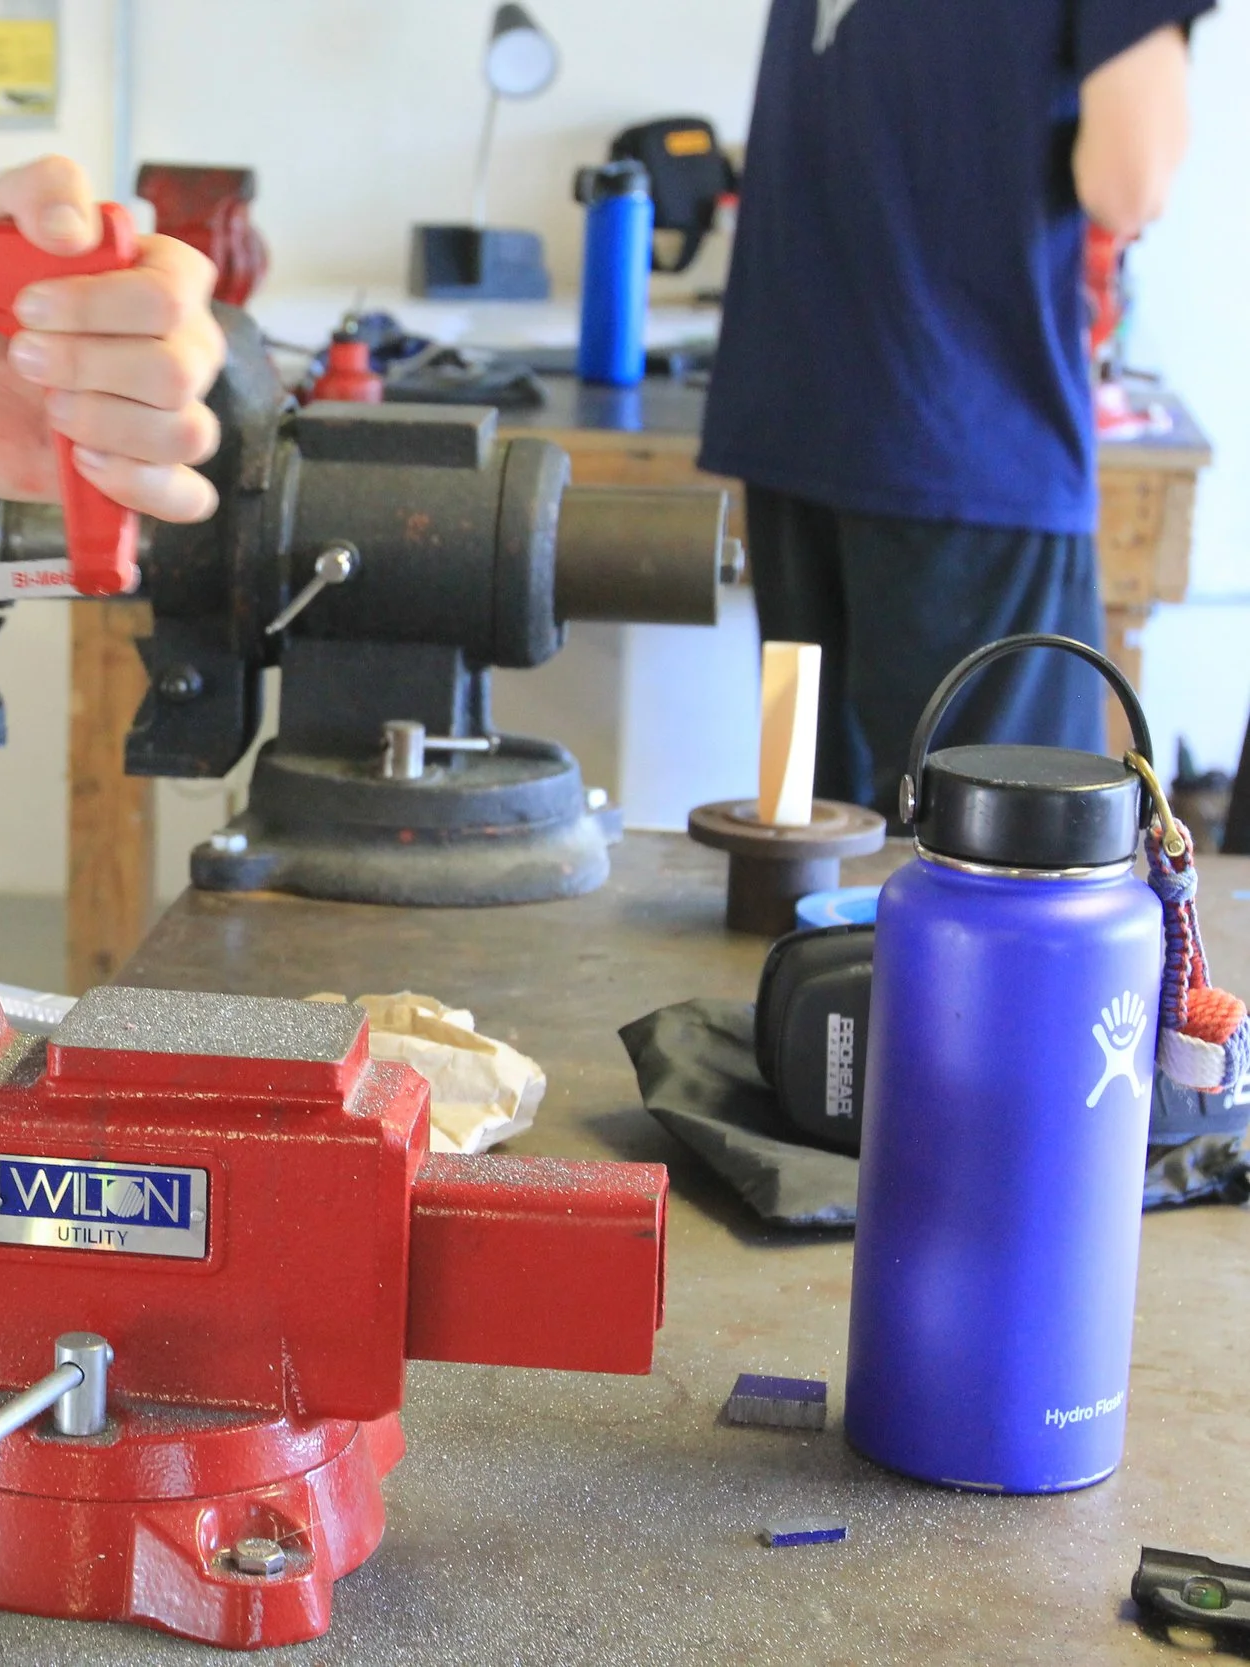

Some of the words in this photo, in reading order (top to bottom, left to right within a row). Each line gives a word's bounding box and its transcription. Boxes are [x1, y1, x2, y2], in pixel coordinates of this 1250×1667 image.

[838, 1018, 854, 1114] PROHEAR
[9, 1167, 179, 1223] WILTON
[58, 1226, 128, 1246] UTILITY
[1045, 1406, 1094, 1429] Hydro
